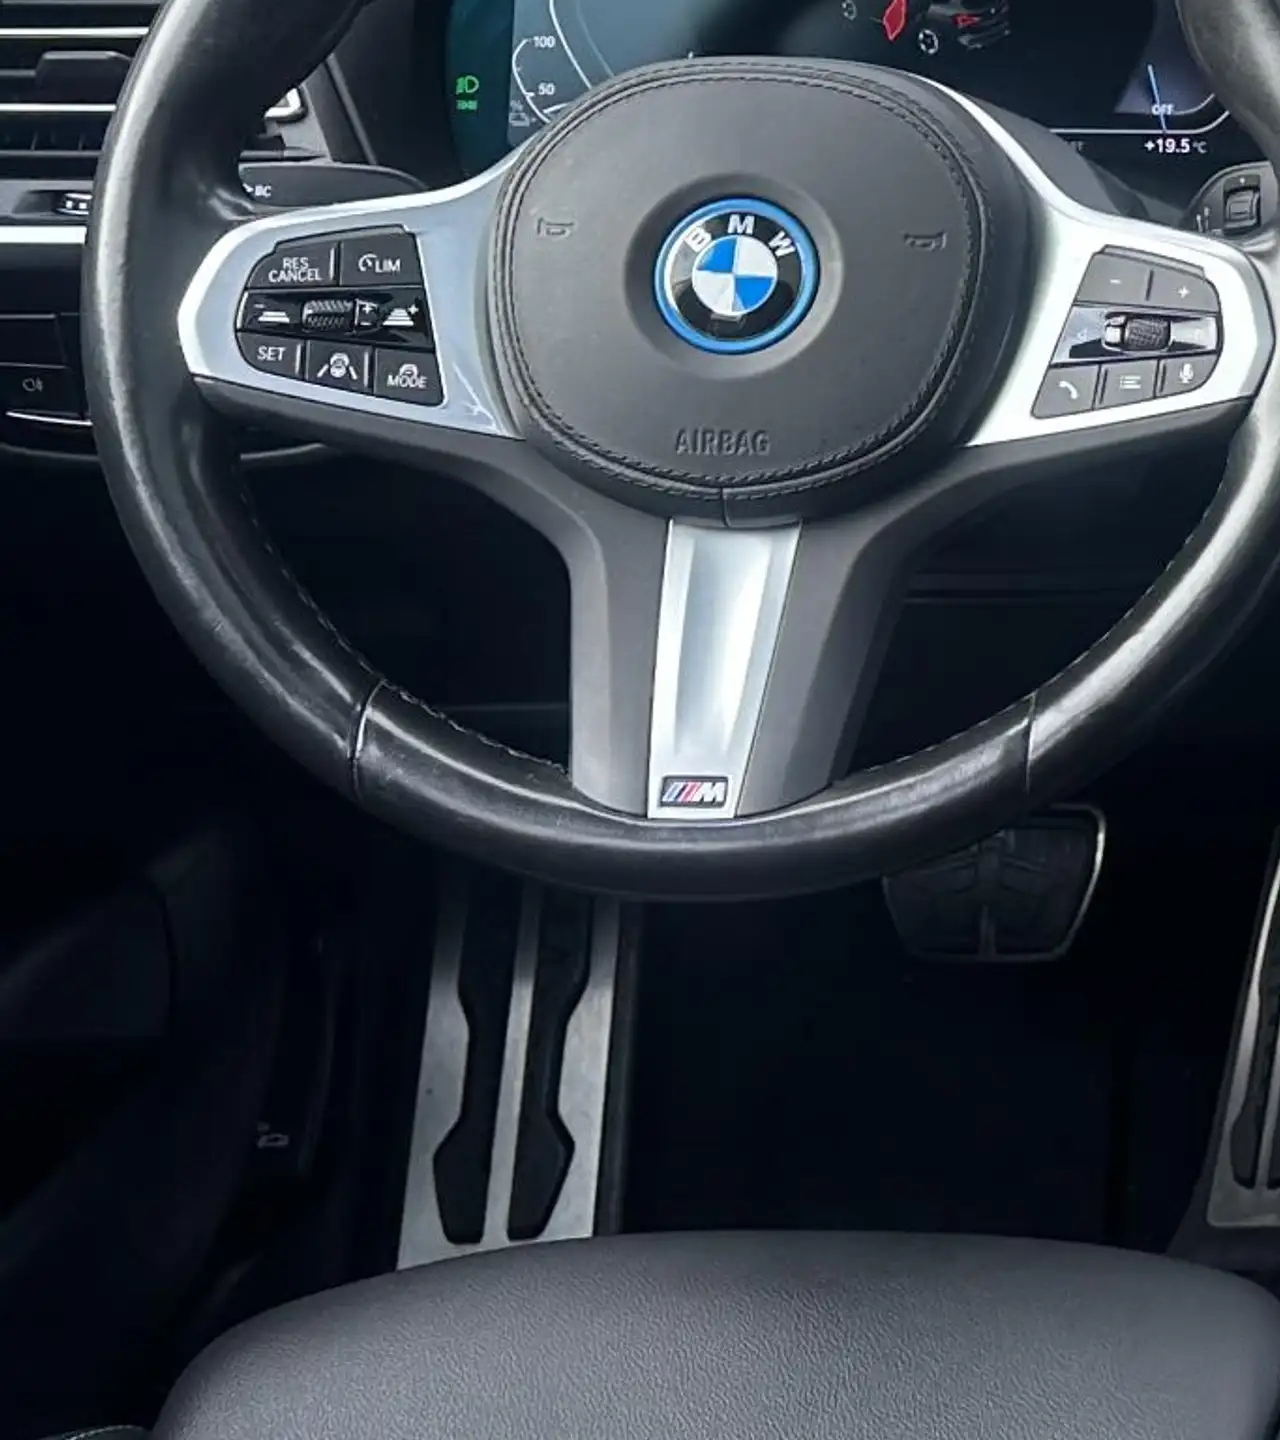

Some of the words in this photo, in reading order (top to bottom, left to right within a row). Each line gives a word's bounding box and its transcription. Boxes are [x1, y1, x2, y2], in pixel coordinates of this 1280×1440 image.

[533, 35, 556, 48] 100
[538, 82, 556, 96] 50
[1144, 137, 1190, 154] +19.5
[684, 213, 796, 258] BMW
[282, 256, 309, 269] RES
[375, 258, 400, 273] LIM
[268, 268, 323, 282] CANCEL
[257, 346, 286, 361] SET
[386, 374, 428, 388] MODE
[675, 427, 771, 456] AIRBAG
